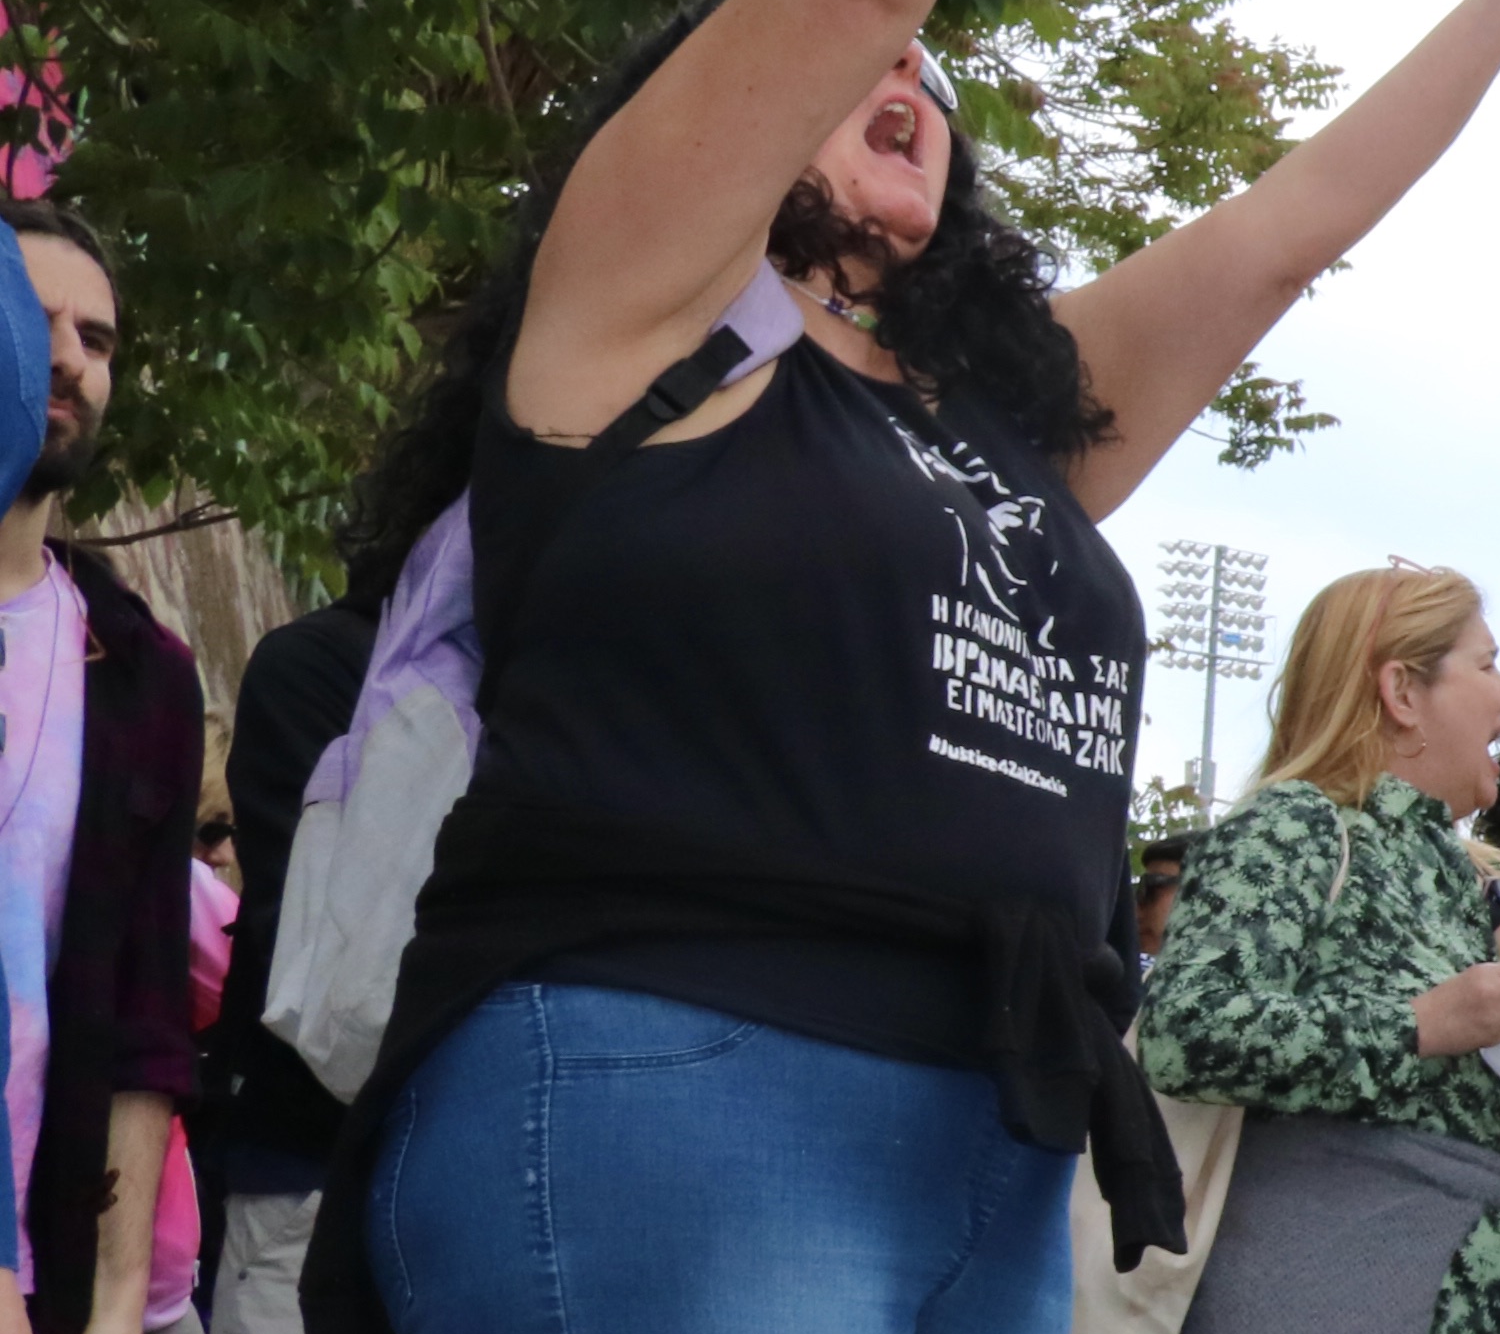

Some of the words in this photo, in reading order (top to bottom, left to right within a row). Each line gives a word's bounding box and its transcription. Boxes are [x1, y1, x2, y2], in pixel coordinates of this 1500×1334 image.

[932, 593, 949, 623] Η
[1090, 654, 1129, 694] ΣΑΣ
[1050, 691, 1122, 735] ΑΙΜΑ
[1075, 730, 1126, 776] ΖΑΚ
